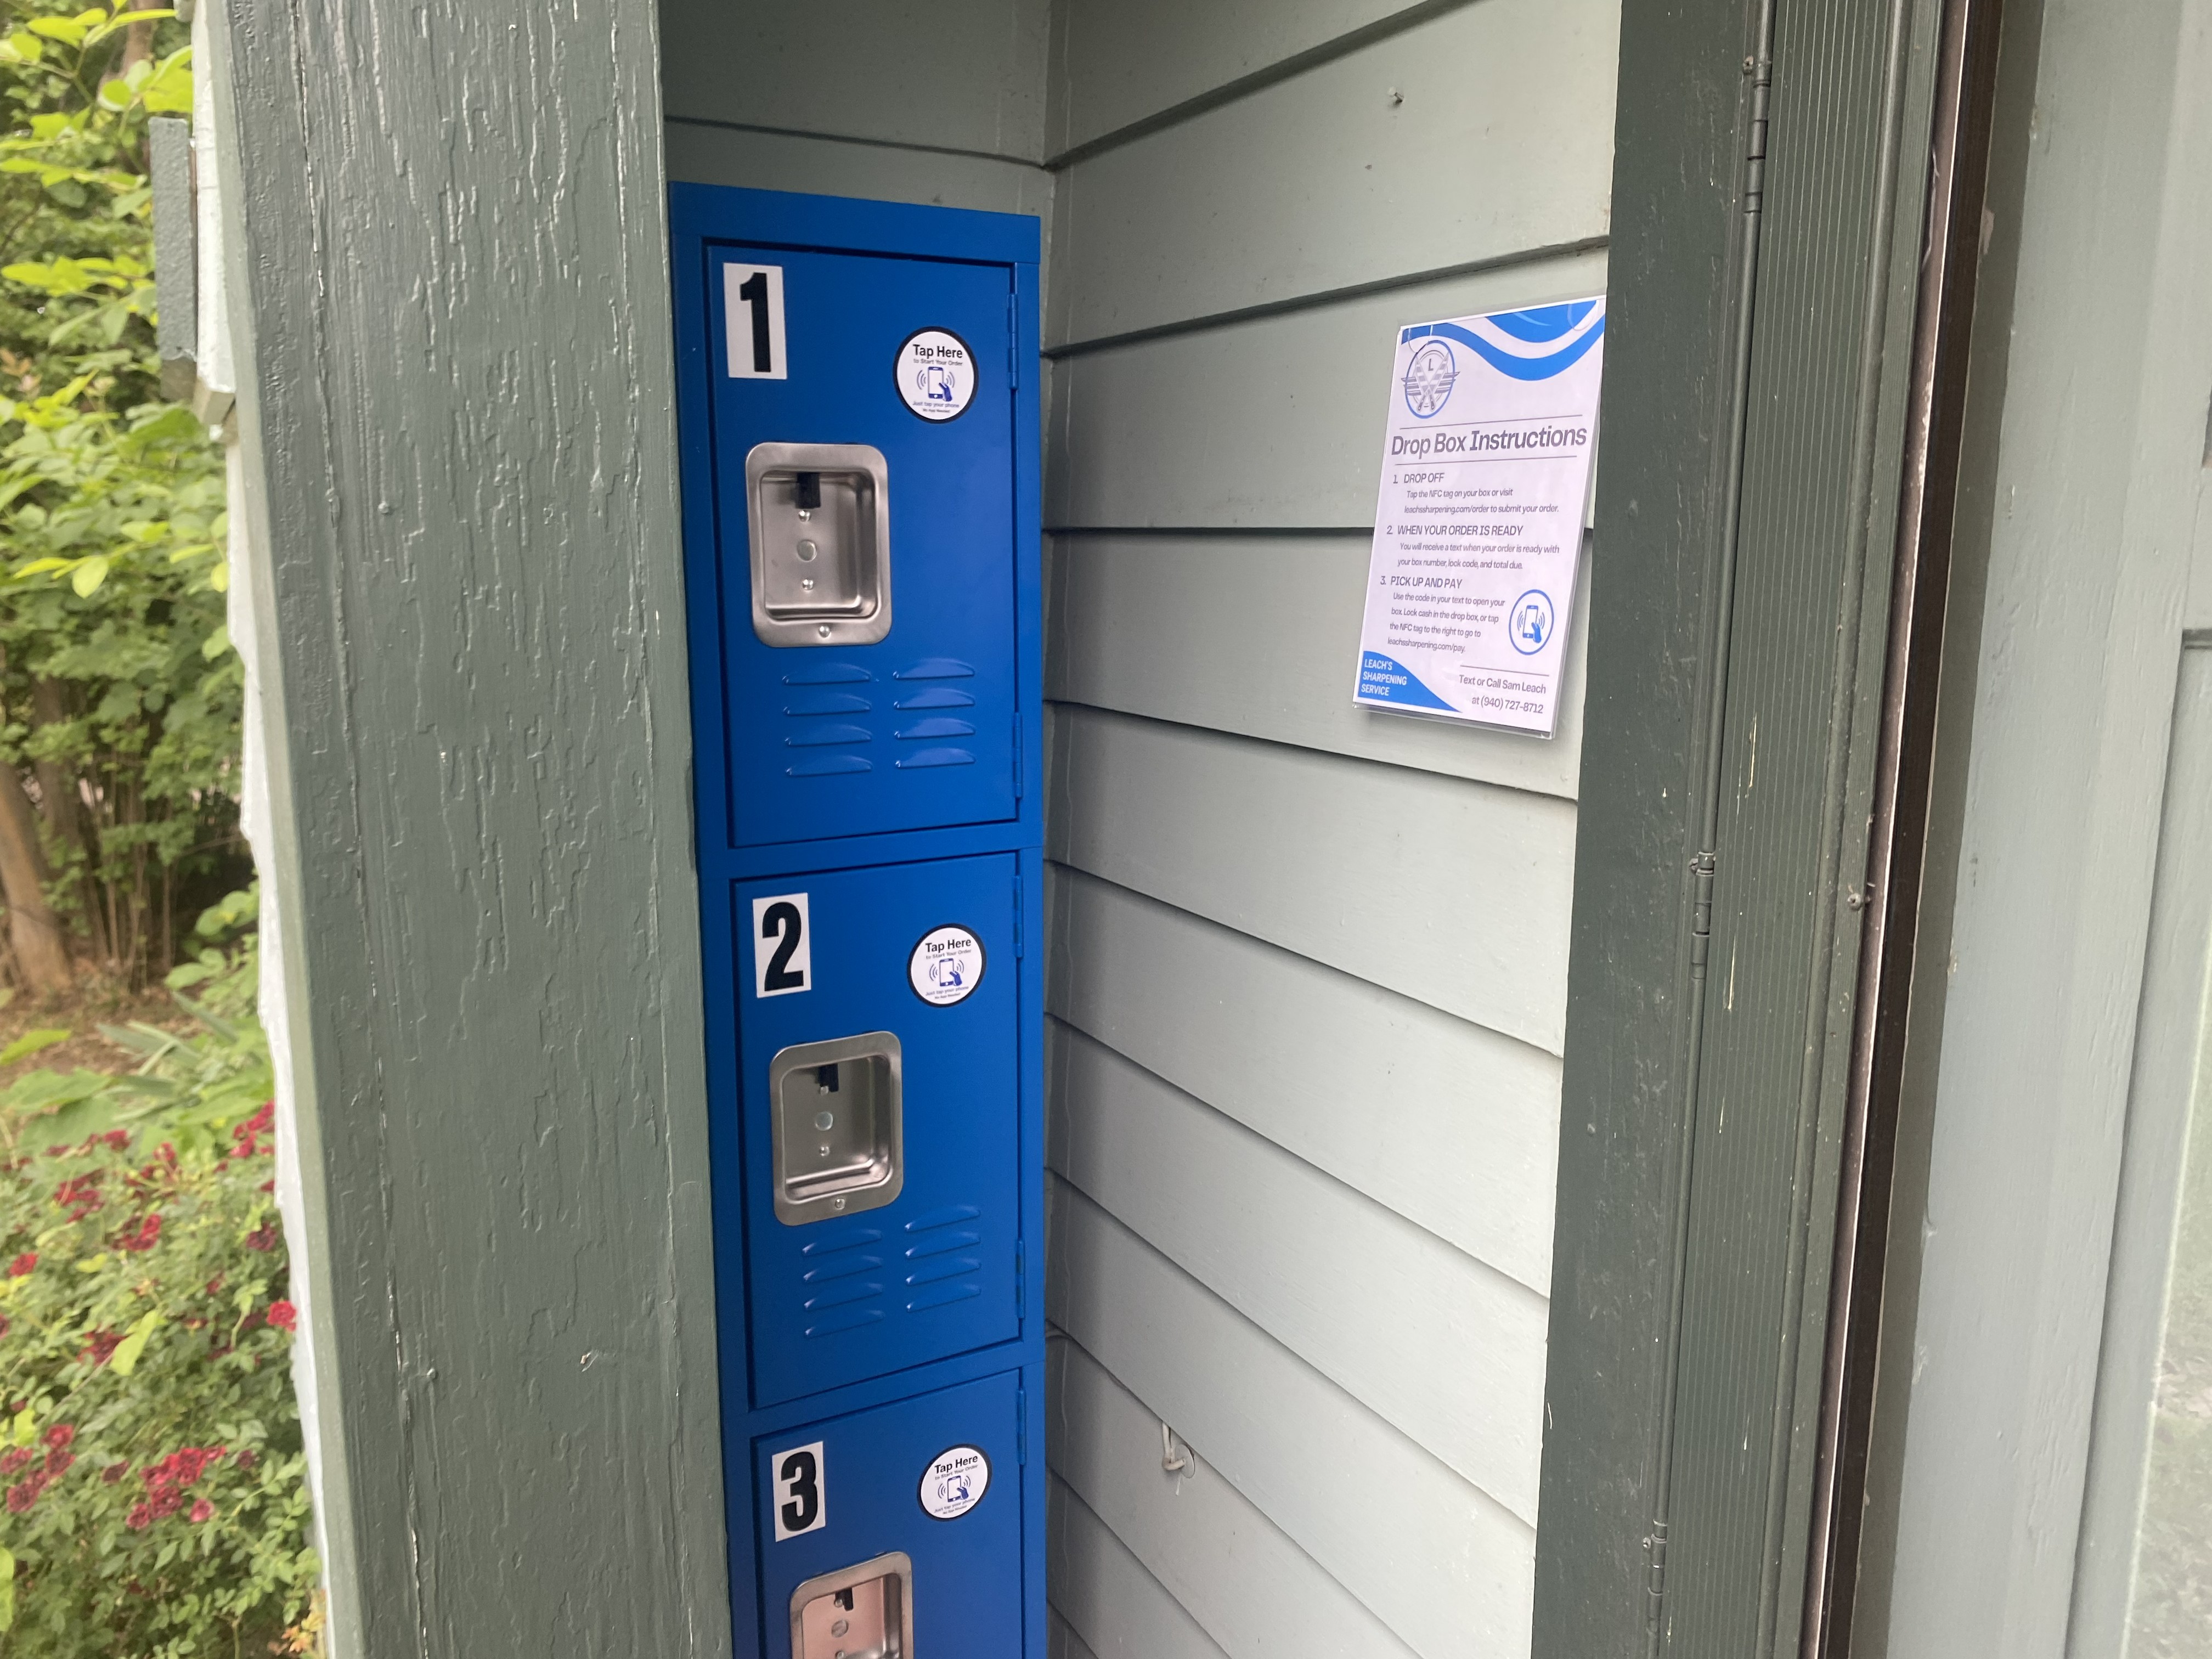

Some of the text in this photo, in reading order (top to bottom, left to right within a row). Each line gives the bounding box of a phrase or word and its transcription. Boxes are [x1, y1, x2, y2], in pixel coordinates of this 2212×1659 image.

[740, 272, 771, 373] 1
[913, 345, 962, 359] Tap Here
[1428, 358, 1434, 371] L
[1391, 425, 1587, 460] Drop Box Instructions
[1404, 473, 1426, 483] DROP
[1427, 472, 1444, 483] OFF
[1407, 490, 1418, 500] Tap
[1443, 490, 1453, 499] tag
[1463, 489, 1477, 499] your
[1479, 488, 1491, 496] box
[1500, 488, 1513, 496] visit
[1498, 503, 1521, 513] submit
[1522, 505, 1538, 515] your
[1539, 503, 1559, 512] order.
[1398, 525, 1423, 535] WHEN
[1424, 525, 1447, 535] YOUR
[1448, 525, 1478, 535] ORDER
[1480, 525, 1490, 535] IS
[1491, 525, 1523, 536] READY
[1463, 543, 1481, 552] when
[1481, 545, 1497, 554] your
[1497, 543, 1515, 552] order
[1516, 544, 1522, 552] is
[1522, 544, 1543, 555] ready
[1544, 545, 1560, 554] with
[1397, 559, 1411, 567] your
[1423, 558, 1447, 568] number,
[1448, 558, 1462, 567] lock
[1462, 560, 1479, 569] code,
[1480, 560, 1493, 568] and
[1493, 560, 1508, 568] total
[1509, 560, 1523, 569] due.
[1380, 575, 1463, 589] 3. PICK UP AND PAY
[1393, 592, 1404, 600] Use
[1405, 592, 1414, 601] the
[1415, 594, 1430, 602] code
[1431, 594, 1436, 602] in
[1472, 599, 1489, 607] open
[1489, 600, 1505, 608] your
[1403, 607, 1417, 617] Lock
[1418, 610, 1432, 618] cash
[1433, 610, 1438, 618] in
[1440, 611, 1449, 619] the
[1451, 611, 1465, 622] drop
[1466, 612, 1479, 623] box,
[1488, 614, 1499, 624] tap
[1390, 622, 1399, 630] the
[1400, 623, 1413, 631] NFC
[1413, 625, 1423, 634] tag
[1431, 625, 1441, 634] the
[1442, 627, 1457, 636] right
[1465, 630, 1473, 639] go
[1364, 659, 1393, 671] LEACH'S
[1363, 671, 1407, 686] SHARPENING
[1459, 675, 1476, 685] Text
[1487, 678, 1501, 688] Call
[1503, 680, 1520, 691] Sam
[1522, 682, 1546, 694] Leach
[1361, 684, 1390, 696] SERVICE
[1472, 695, 1544, 714] at (940) 727-8712
[762, 902, 804, 991] 2
[926, 939, 971, 953] Tap Here
[935, 1456, 978, 1474] Tap Here
[781, 1452, 818, 1532] 3
